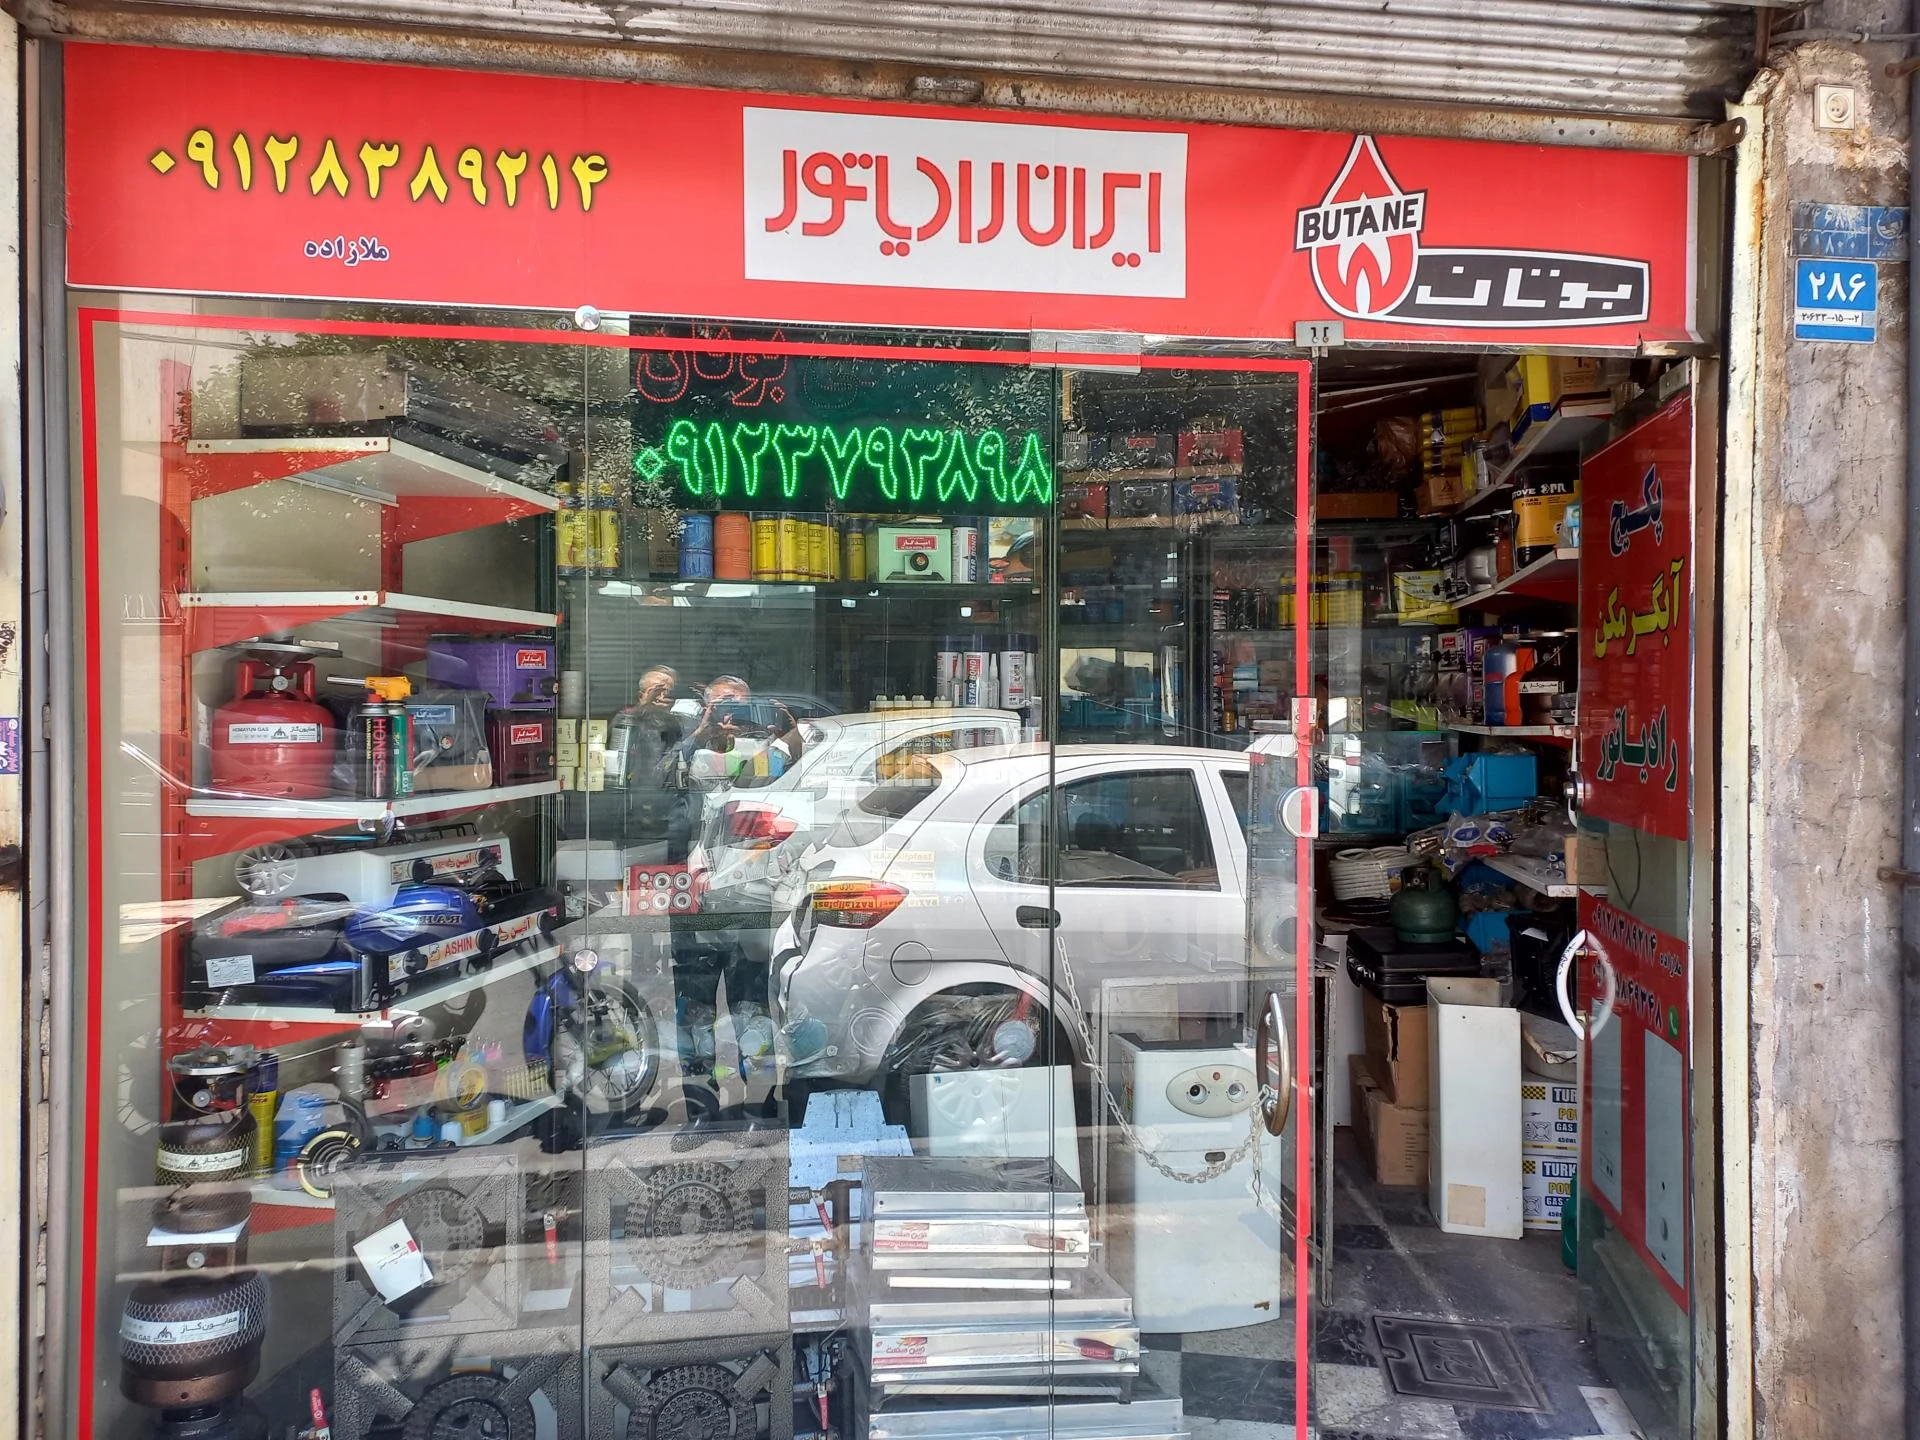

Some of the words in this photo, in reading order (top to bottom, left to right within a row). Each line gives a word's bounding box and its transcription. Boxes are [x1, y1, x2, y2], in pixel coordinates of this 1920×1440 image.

[149, 127, 609, 212] ۰۹۱۲۸۳۸۹۲۱۴
[764, 148, 1007, 258] رادیاتور
[1016, 163, 1162, 269] ایران
[1303, 195, 1419, 242] BUTANE
[303, 235, 390, 267] ملازاده
[1415, 266, 1633, 311] بوتان
[1808, 271, 1867, 303] ۲۸۶
[634, 418, 1052, 504] ۰۹۱۲۳۷۹۳۸۹۸
[1609, 462, 1664, 558] پکیج
[1594, 557, 1685, 659] آبگرمکن
[968, 660, 976, 680] BOND
[968, 682, 976, 705] STAR
[373, 717, 387, 776] HONEST
[1596, 704, 1679, 793] رادیاتور
[444, 936, 473, 957] ASHIN
[1556, 1123, 1574, 1132] GAS
[1546, 1197, 1564, 1206] GAS
